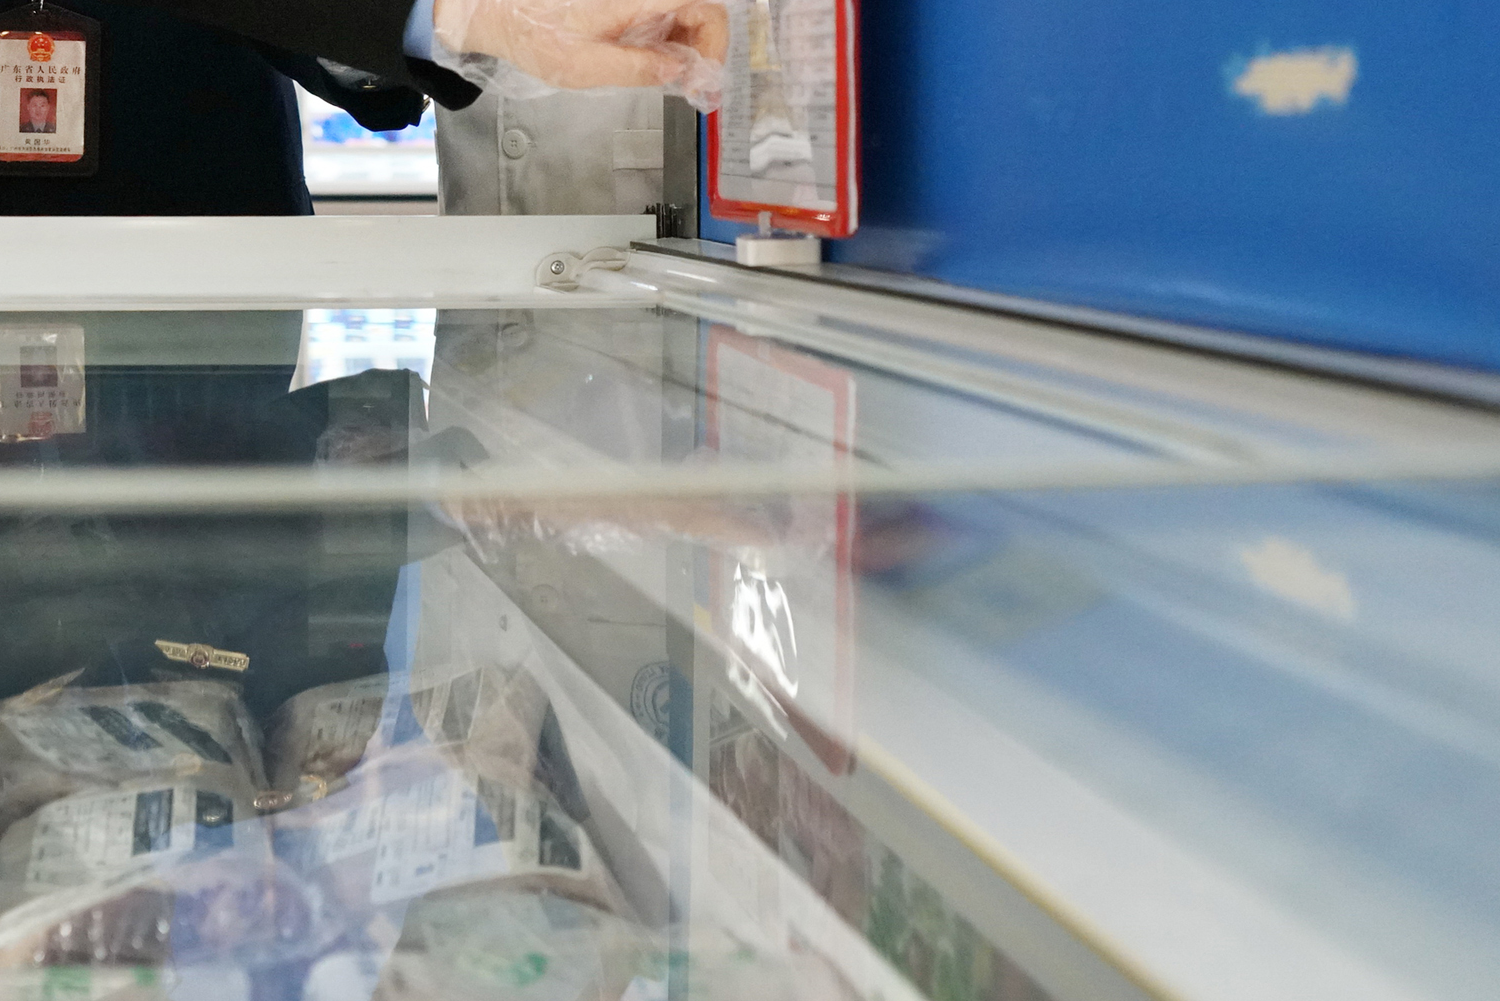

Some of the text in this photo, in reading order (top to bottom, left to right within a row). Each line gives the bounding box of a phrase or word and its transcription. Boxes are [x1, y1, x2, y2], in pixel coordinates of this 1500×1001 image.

[0, 64, 81, 76] 广东省人民政府
